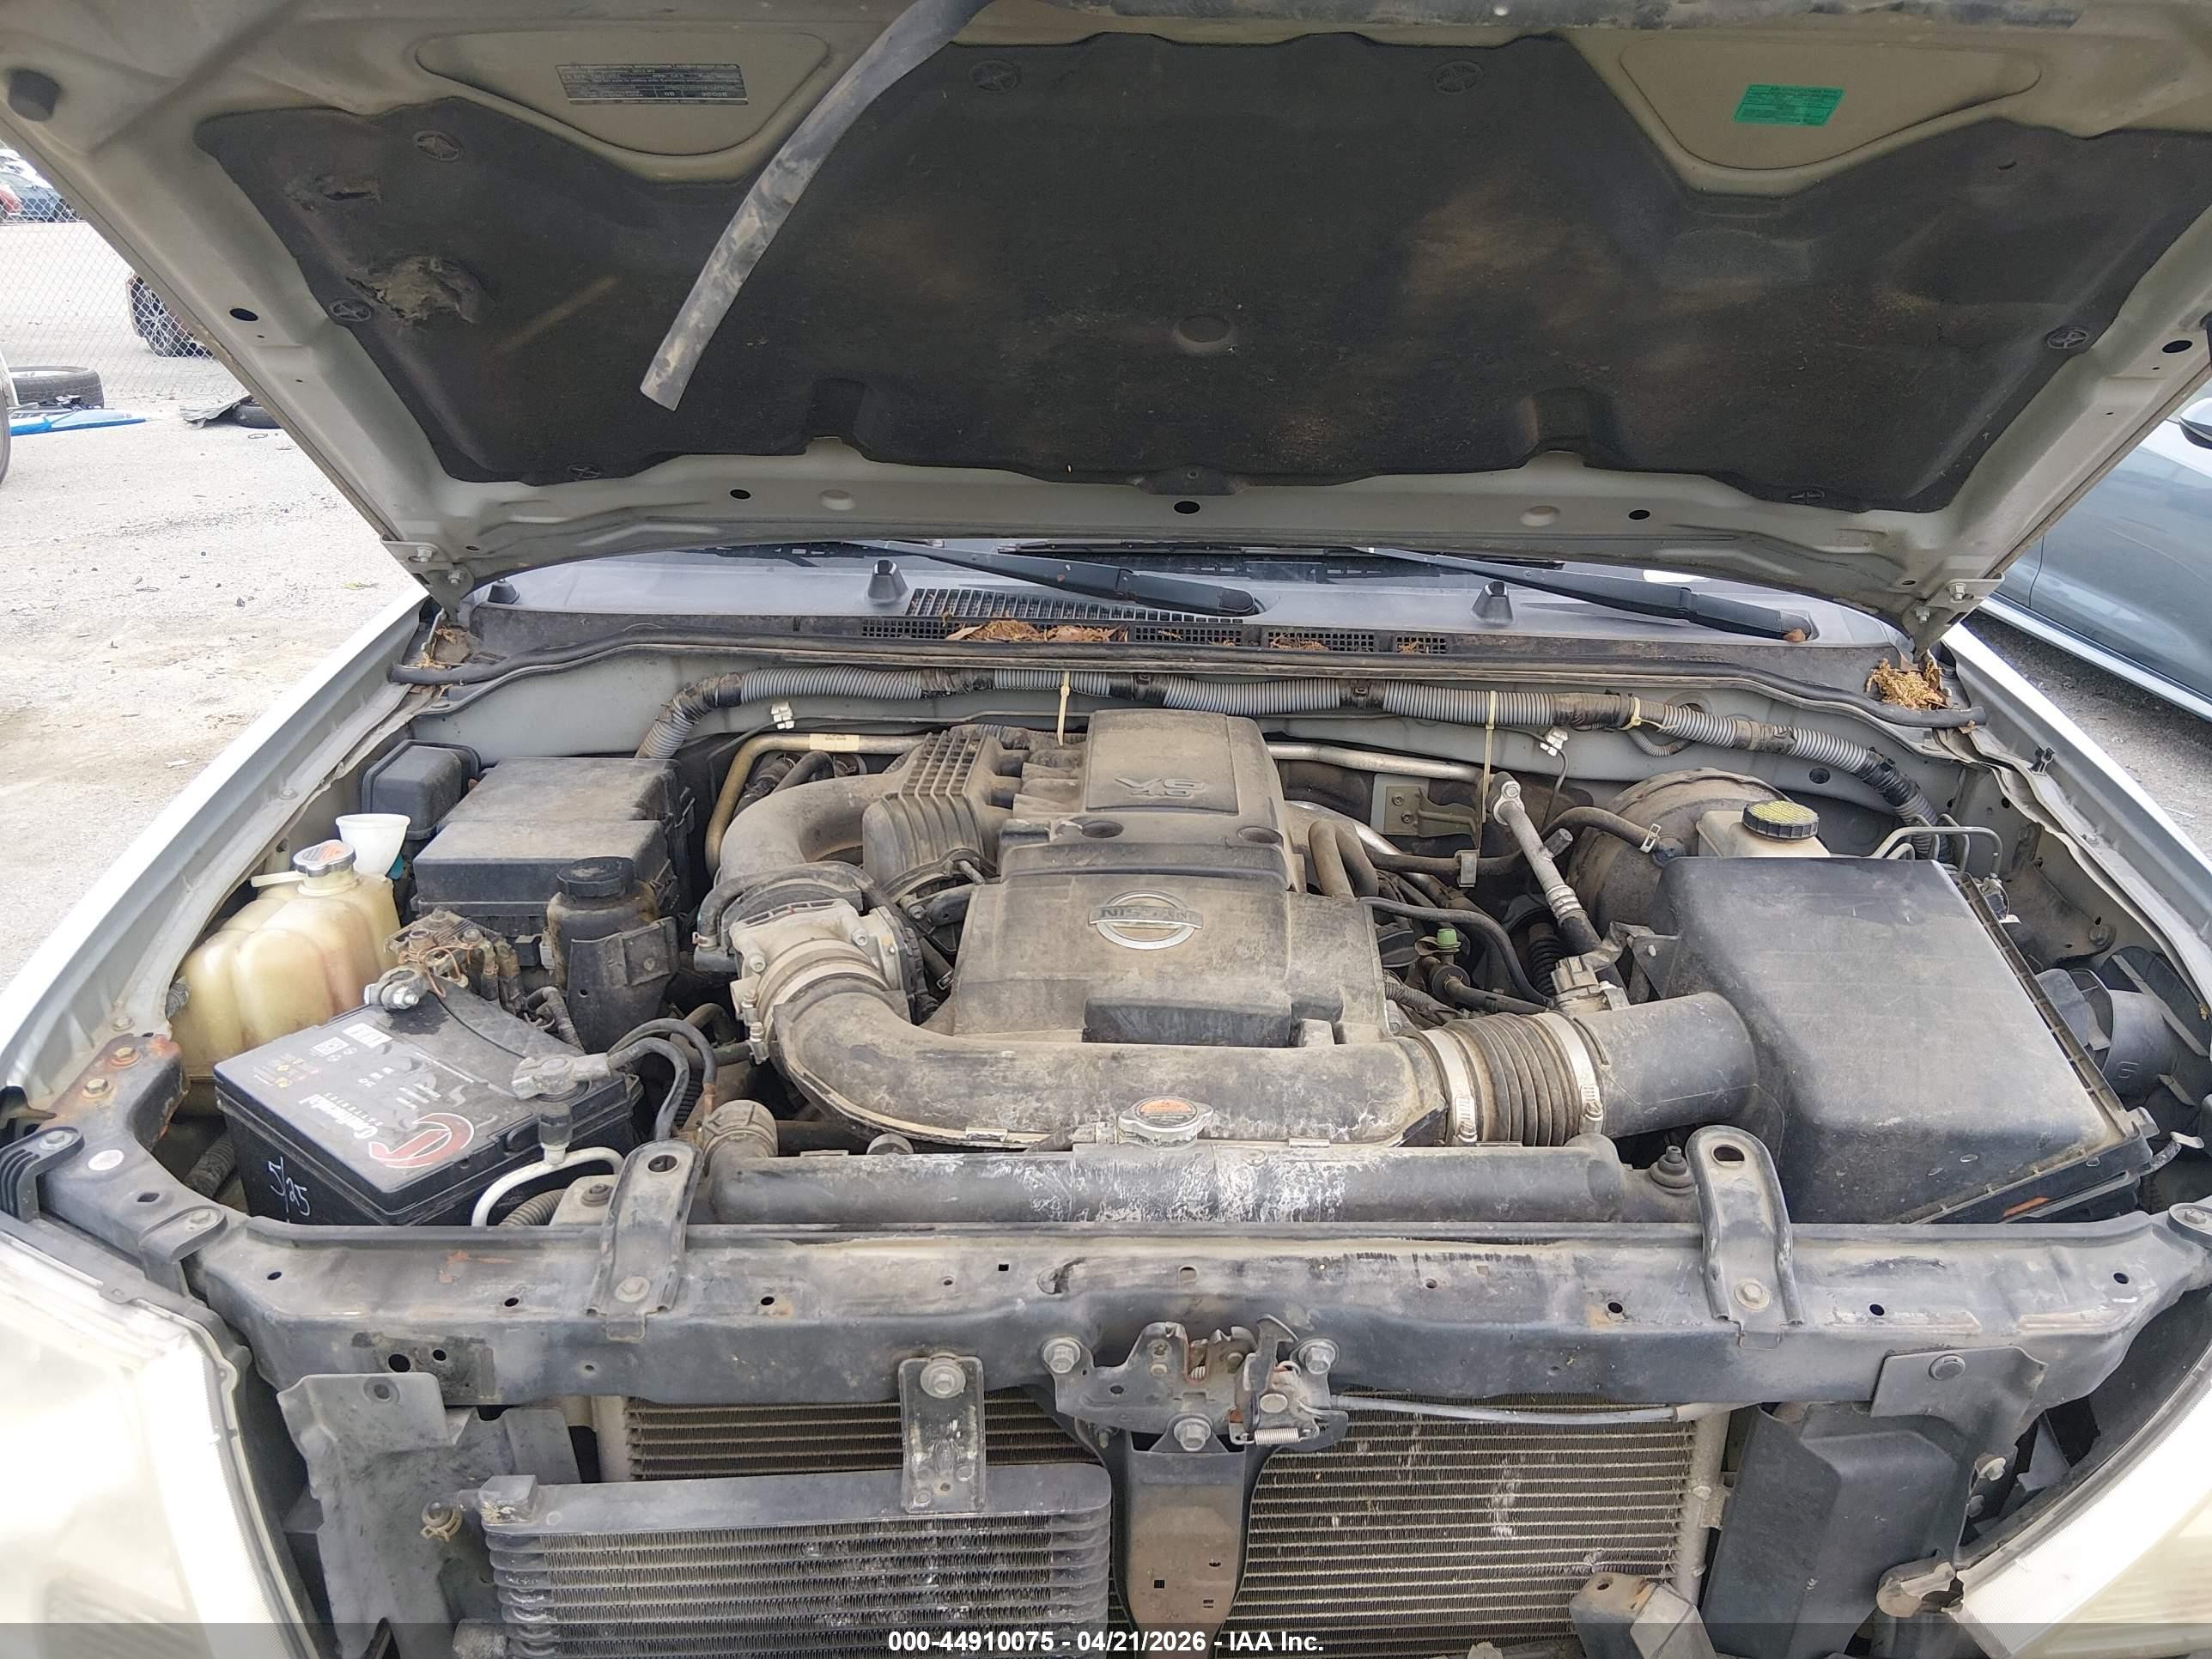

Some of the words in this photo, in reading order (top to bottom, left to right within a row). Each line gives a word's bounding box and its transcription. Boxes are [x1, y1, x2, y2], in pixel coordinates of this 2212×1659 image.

[1114, 776, 1206, 792] V6
[1099, 907, 1192, 923] NISSAN
[268, 1156, 310, 1216] 5/25
